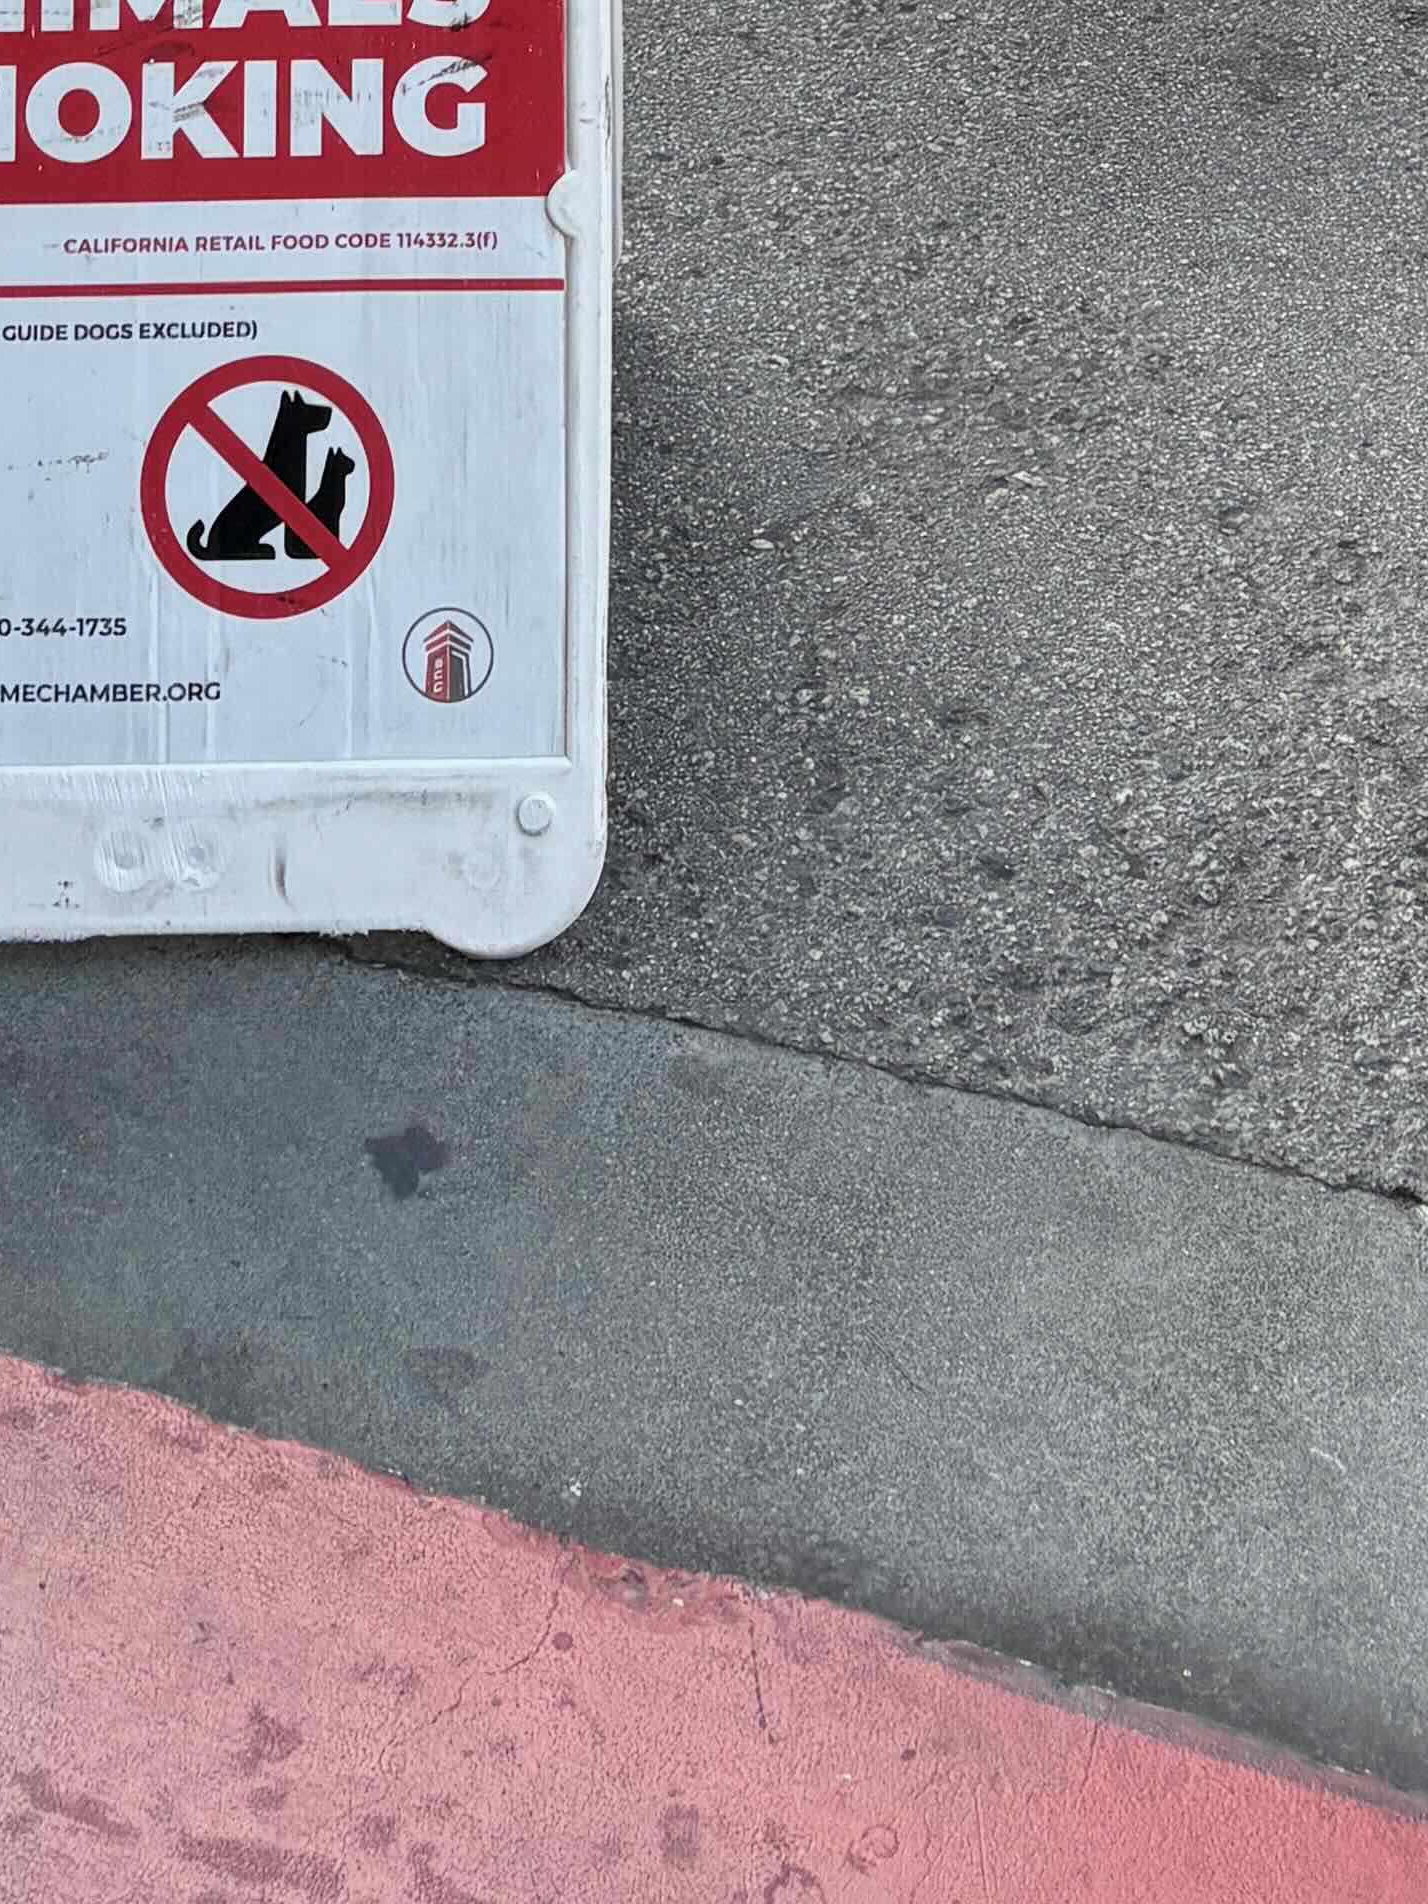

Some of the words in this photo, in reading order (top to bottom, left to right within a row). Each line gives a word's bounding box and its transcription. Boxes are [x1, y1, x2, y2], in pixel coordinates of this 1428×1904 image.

[63, 236, 189, 254] CALIFORNIA
[195, 235, 266, 252] RETAIL
[271, 234, 329, 250] FOOD
[334, 232, 392, 249] CODE
[396, 231, 499, 250] 114332.3(f)
[2, 323, 69, 341] GUIDE
[73, 322, 133, 341] DOGS
[138, 320, 258, 341] EXCLUDED)
